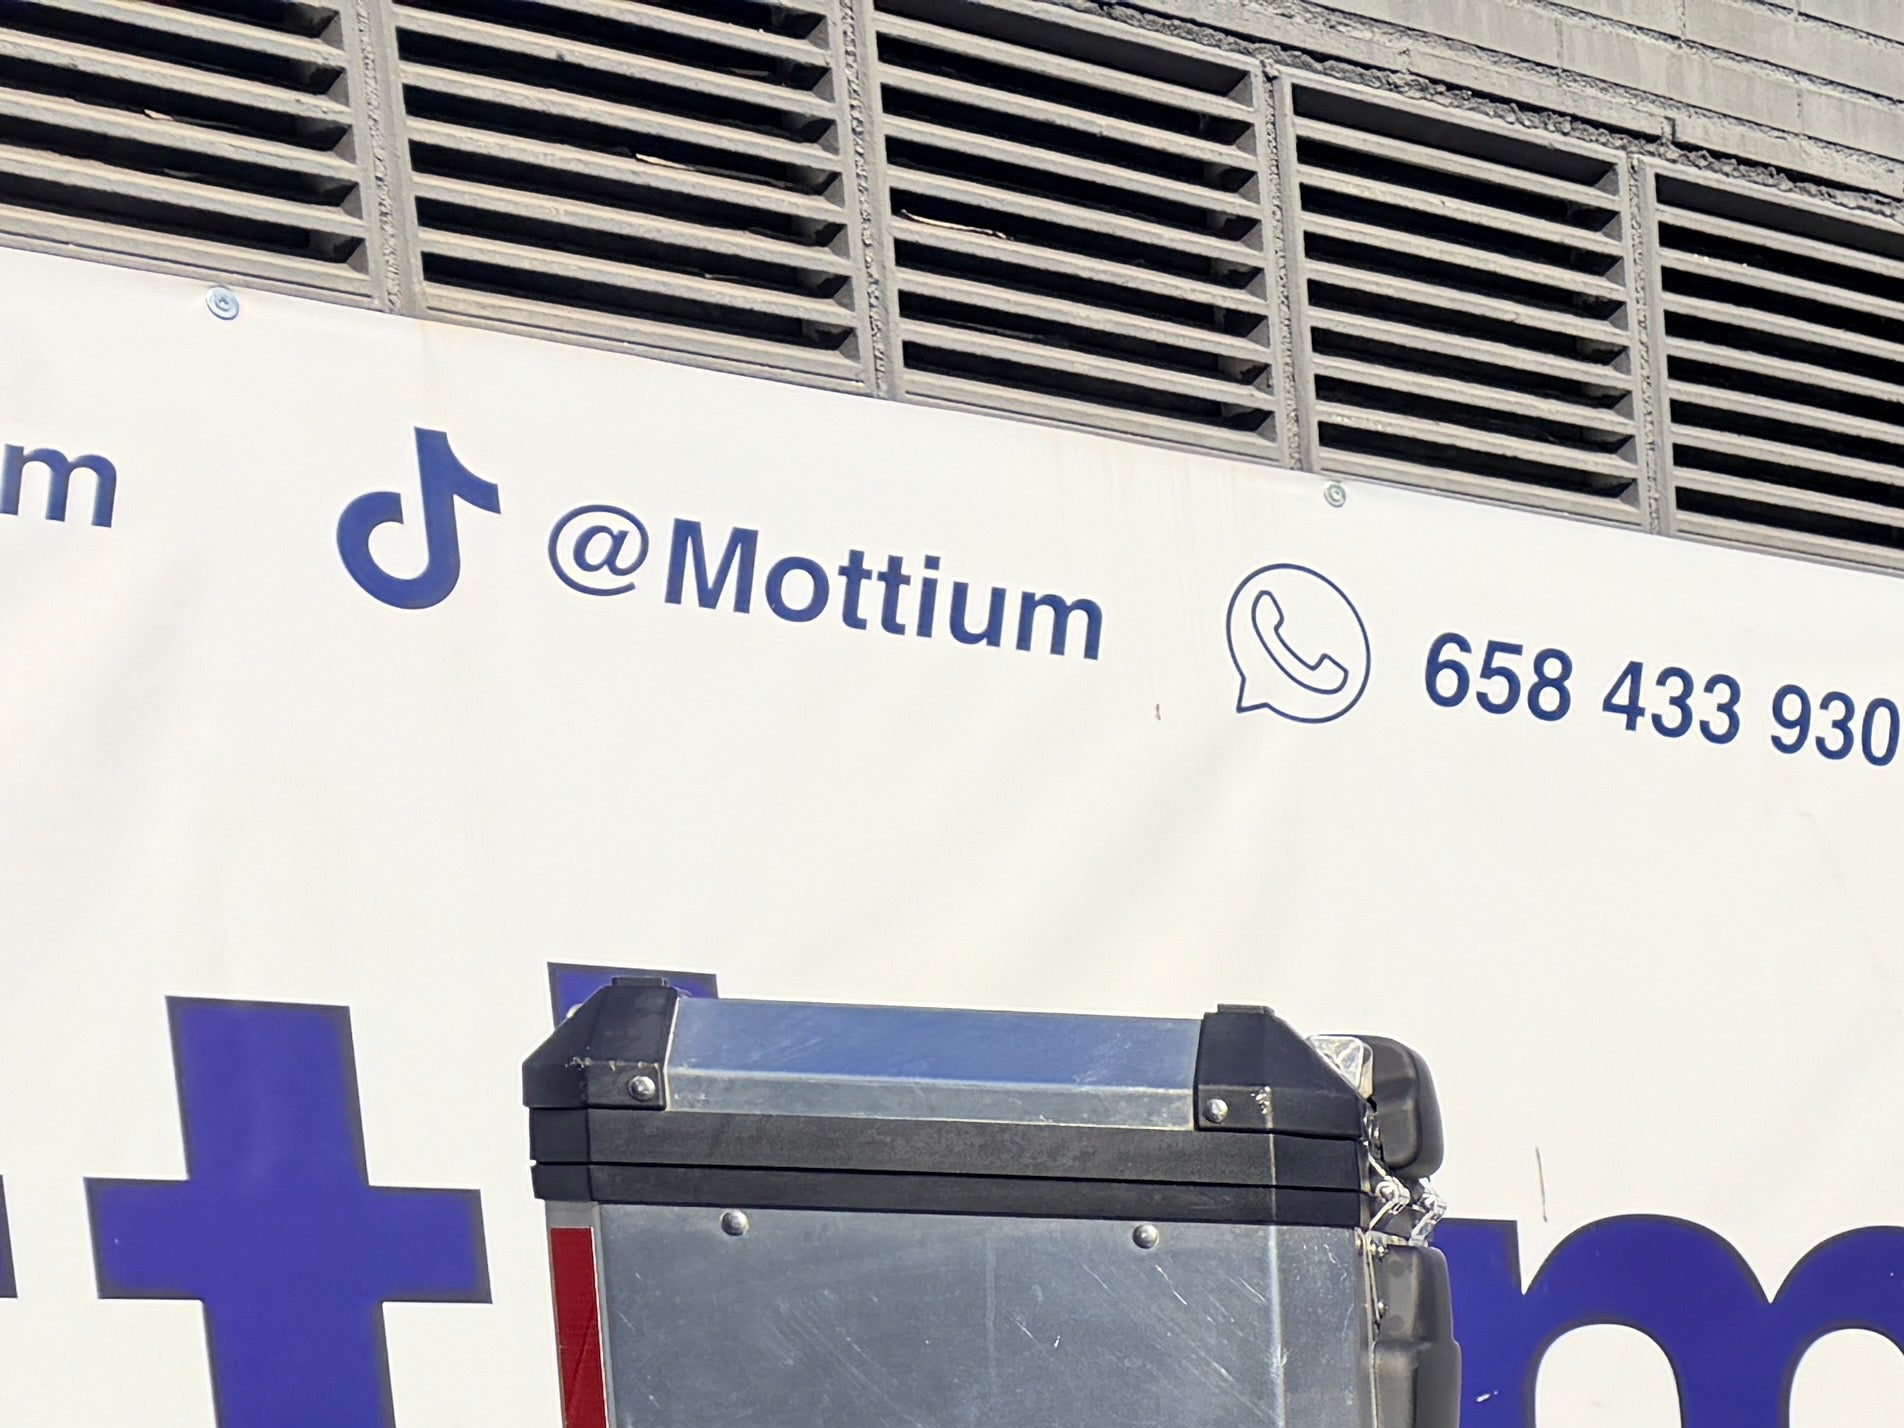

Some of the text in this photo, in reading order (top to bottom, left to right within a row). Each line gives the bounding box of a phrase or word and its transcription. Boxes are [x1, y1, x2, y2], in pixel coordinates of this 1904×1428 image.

[547, 503, 1104, 660] @Mottium
[1424, 632, 1901, 767] 658 433 930
